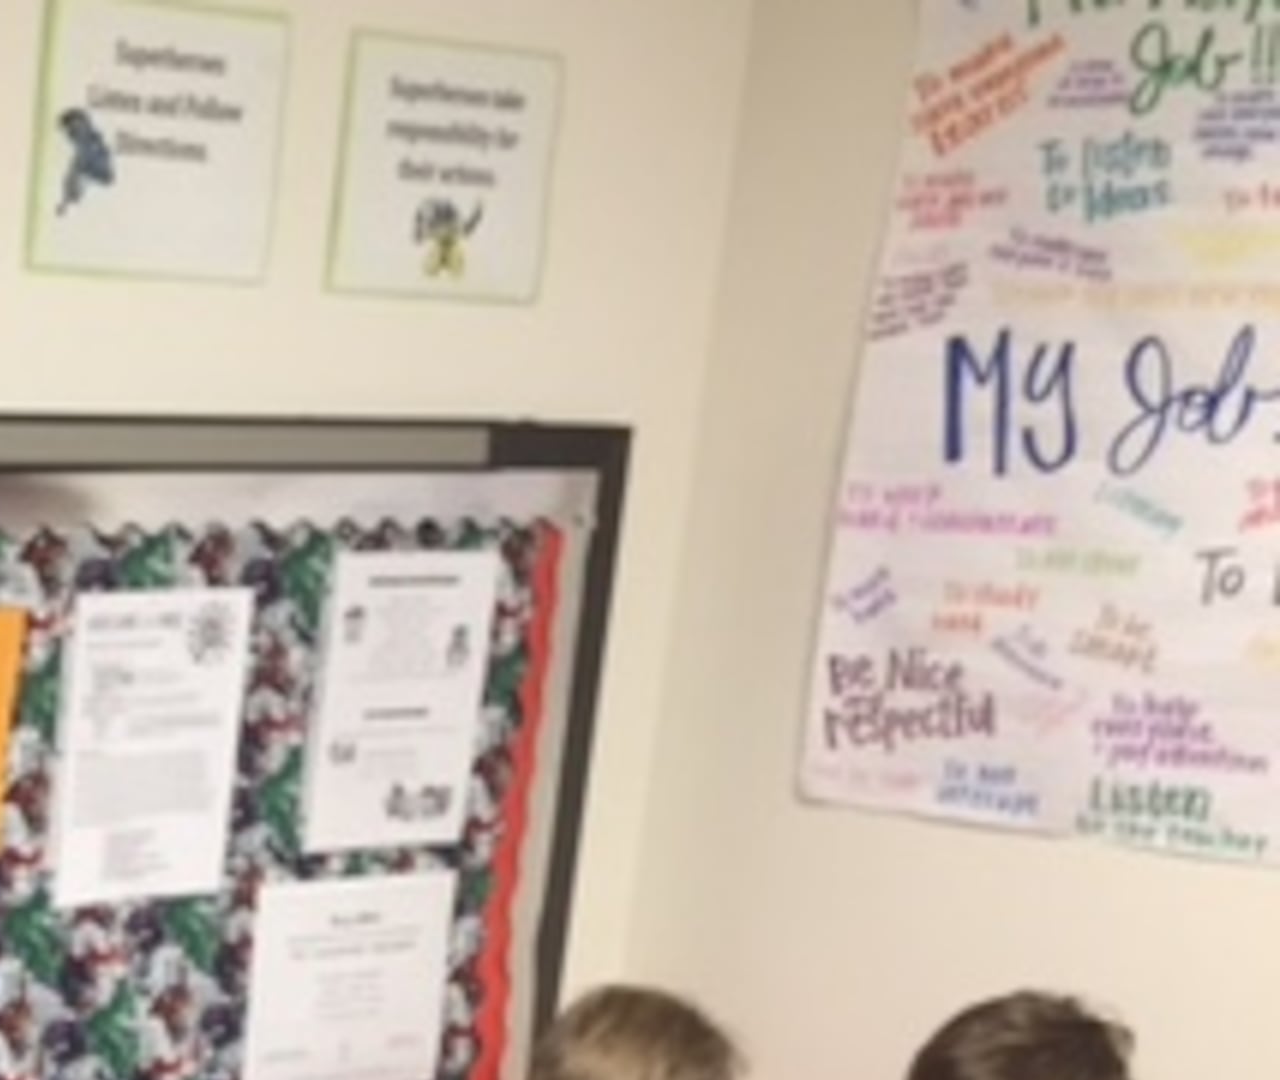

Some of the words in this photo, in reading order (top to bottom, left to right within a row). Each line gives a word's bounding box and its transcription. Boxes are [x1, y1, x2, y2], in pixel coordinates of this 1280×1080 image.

[114, 35, 226, 74] Superheroes
[145, 92, 179, 117] and
[389, 73, 490, 108] Superheroes
[385, 119, 491, 153] responsibility
[944, 326, 1078, 478] My
[1195, 546, 1246, 607] To
[1089, 776, 1213, 824] Listen
